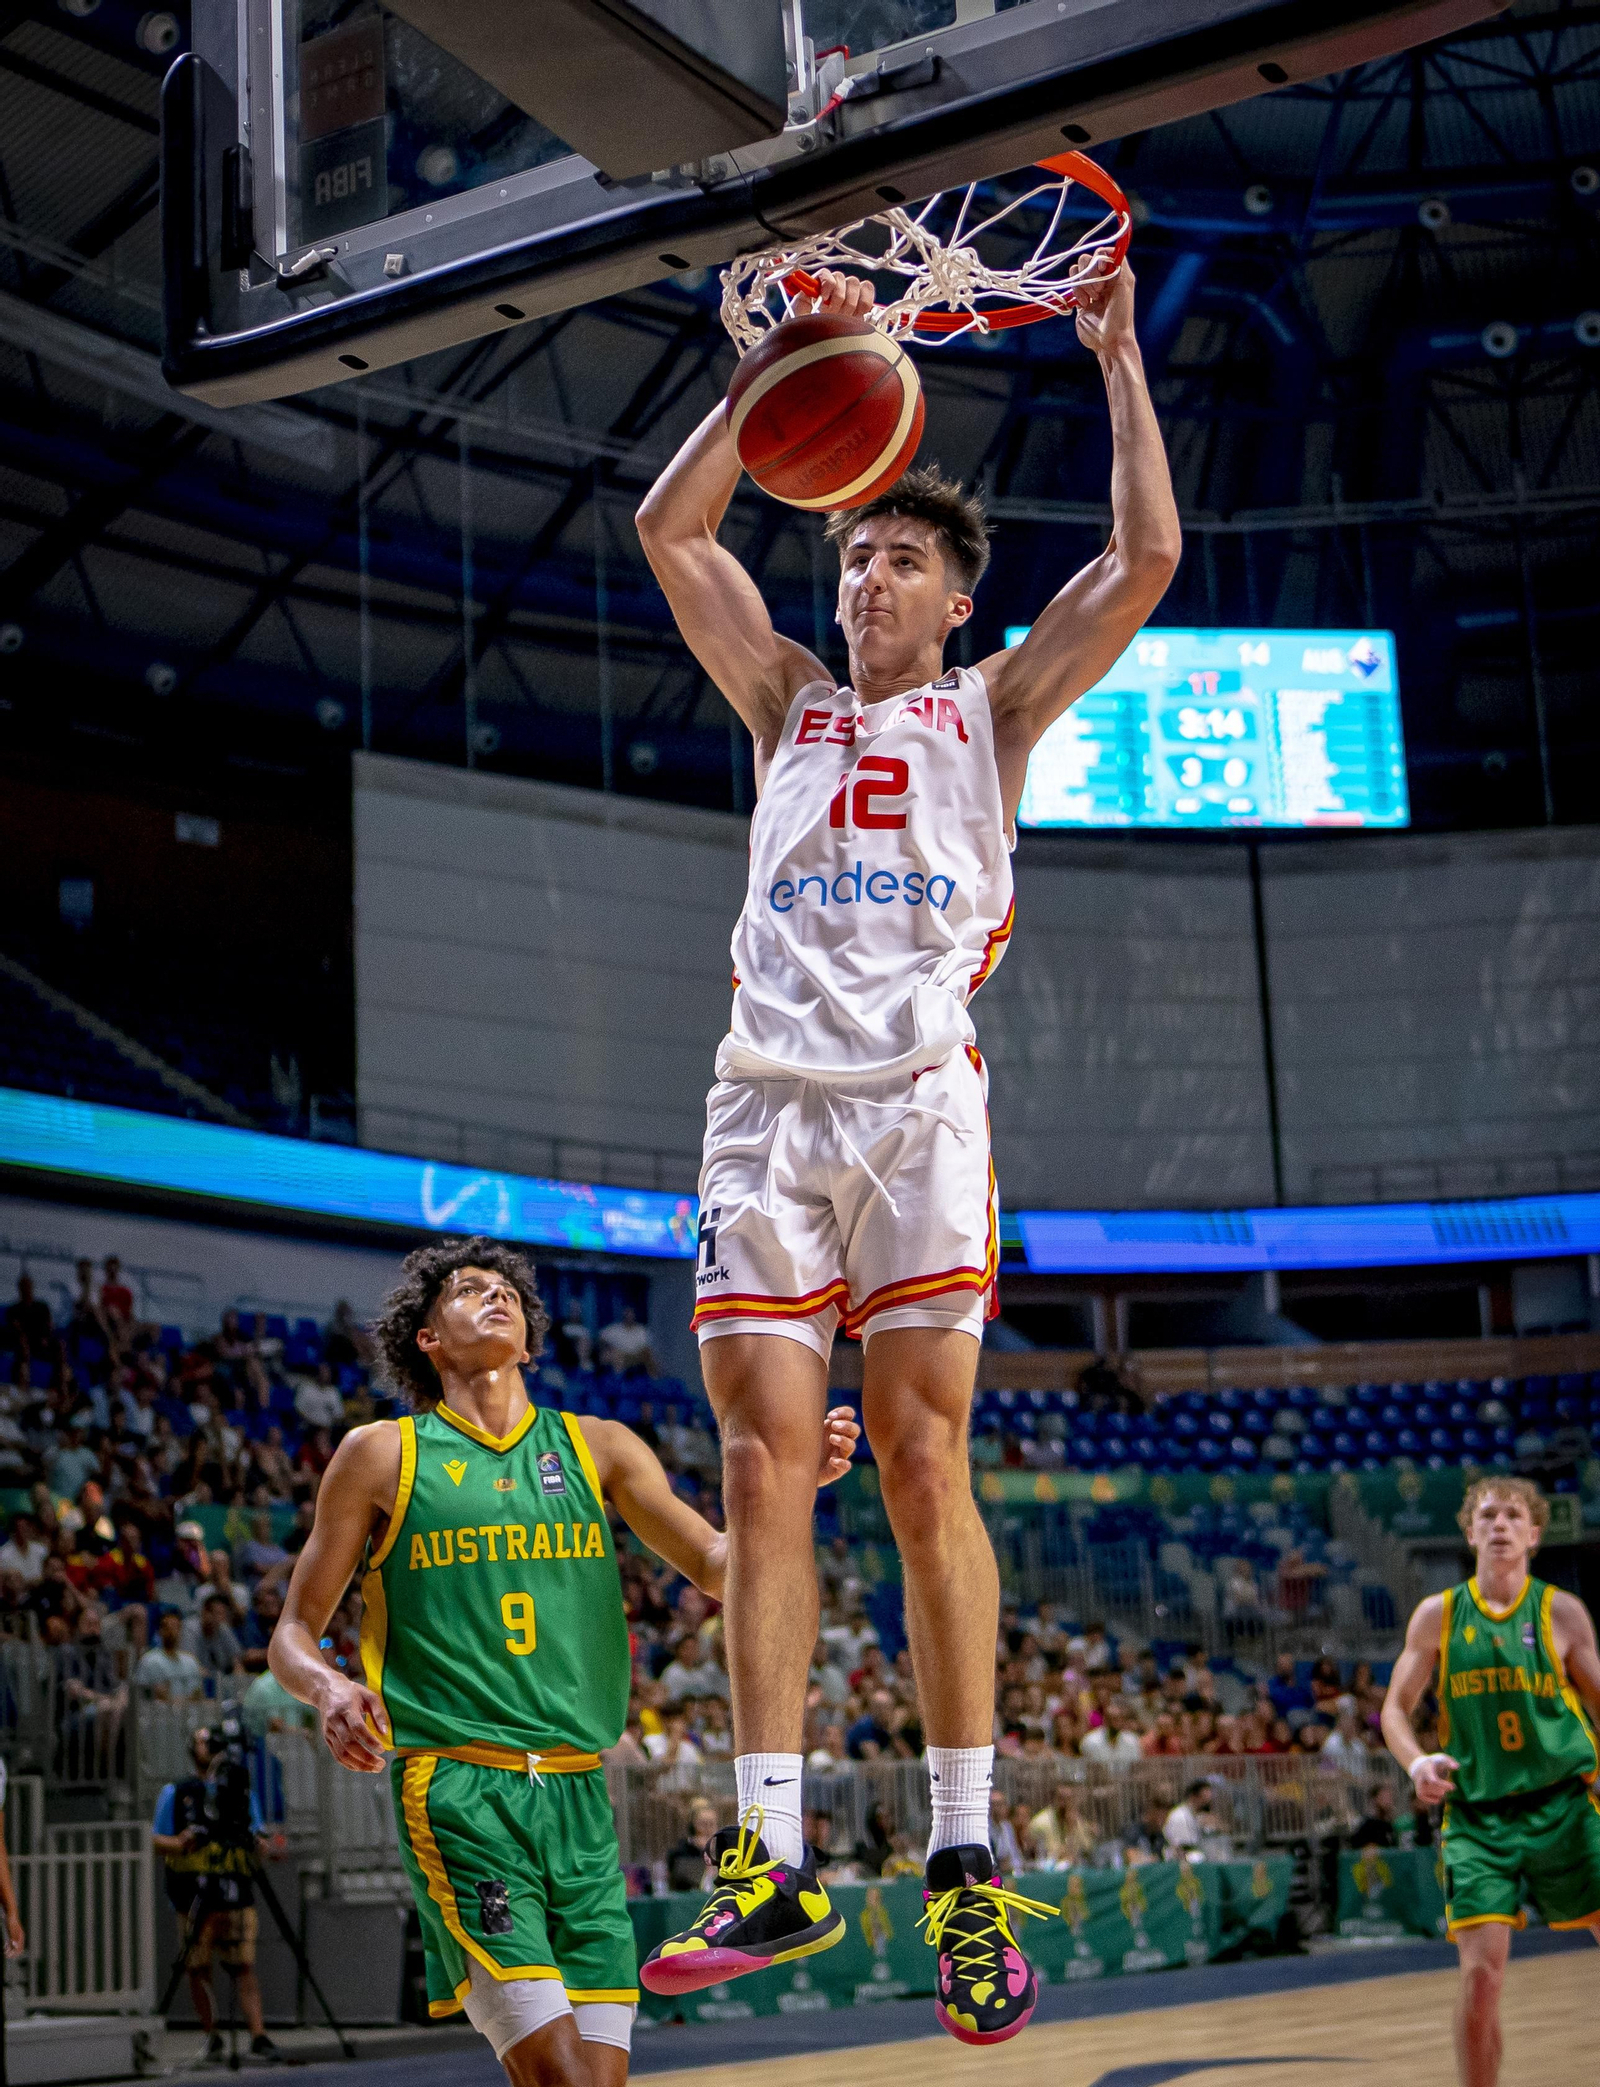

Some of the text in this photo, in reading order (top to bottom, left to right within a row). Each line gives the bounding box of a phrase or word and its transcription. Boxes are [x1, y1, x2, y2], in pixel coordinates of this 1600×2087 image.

[1136, 640, 1169, 667] 12
[1238, 642, 1271, 667] 14
[1178, 707, 1246, 740] 3:14
[1180, 756, 1203, 788] 3
[829, 755, 910, 830] 12
[769, 861, 957, 914] endesa
[543, 1474, 562, 1485] FIBA
[409, 1522, 605, 1570] AUSTRALIA
[500, 1591, 538, 1657] 9
[1497, 1710, 1525, 1751] 8
